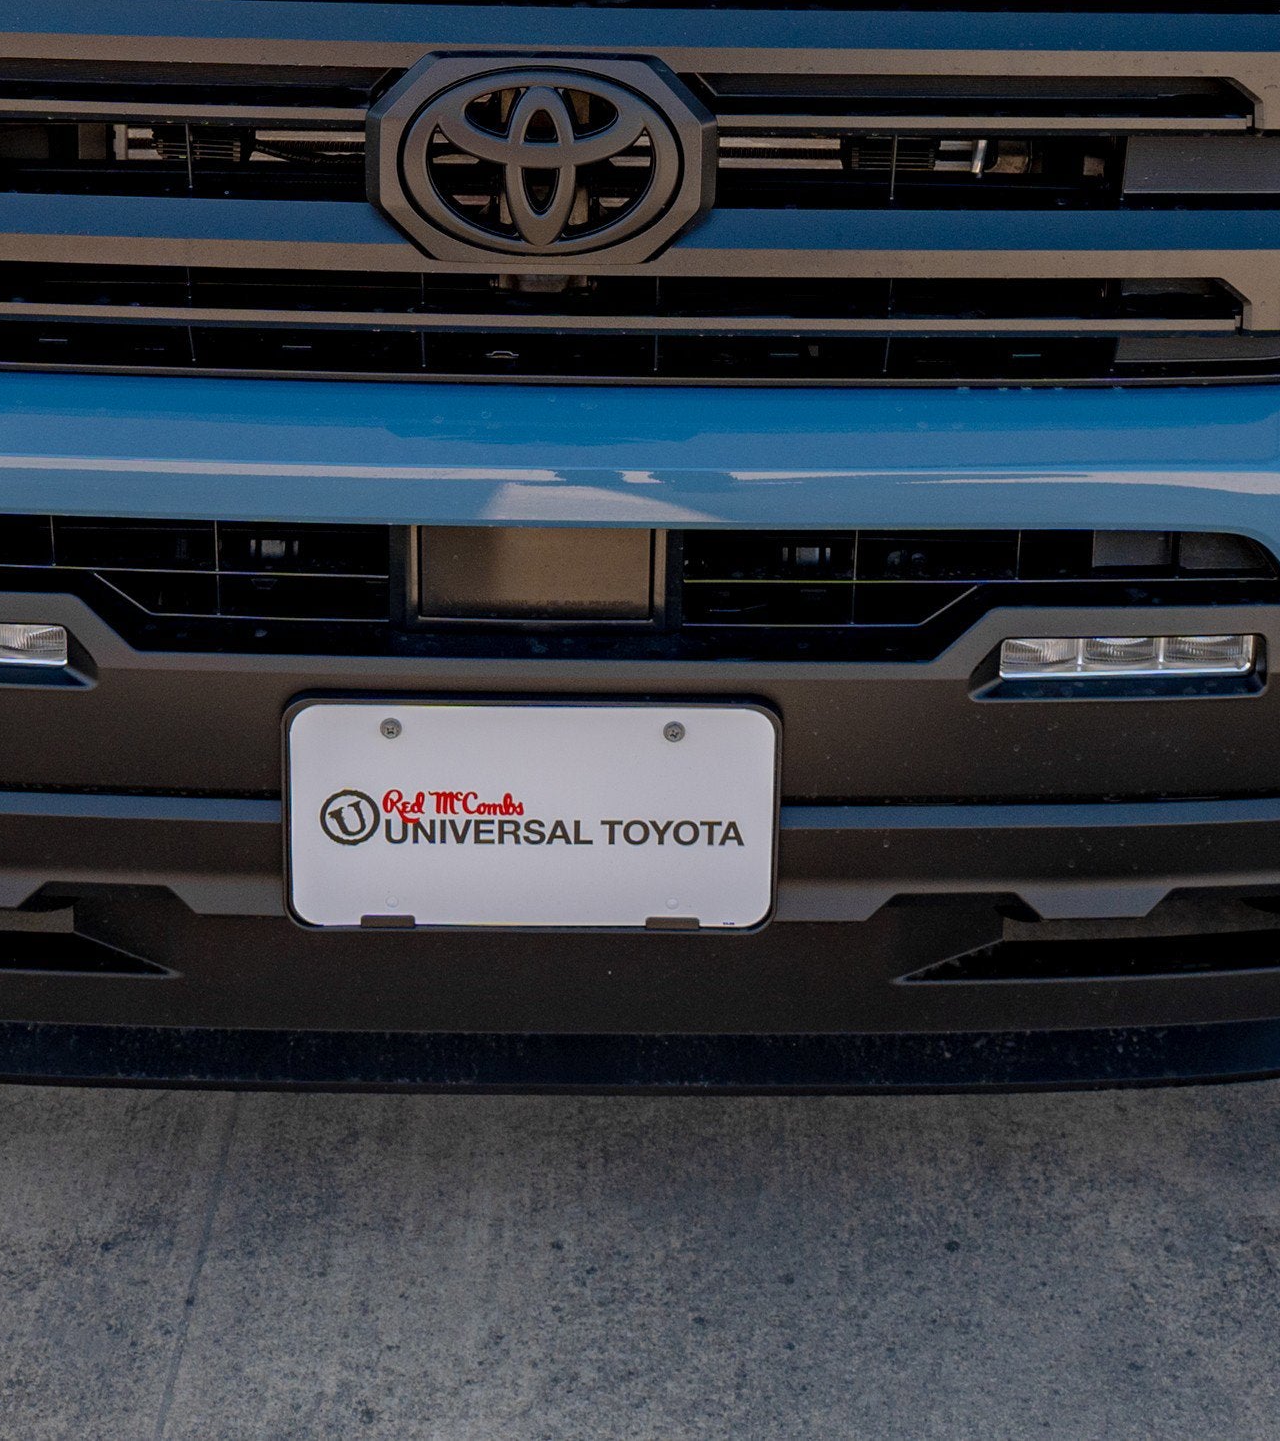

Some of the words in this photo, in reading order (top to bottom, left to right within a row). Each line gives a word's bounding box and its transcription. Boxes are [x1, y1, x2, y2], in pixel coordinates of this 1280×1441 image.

[382, 788, 426, 824] Red
[428, 790, 525, 818] McCombs
[383, 818, 593, 846] UNIVERSAL
[600, 819, 745, 847] TOYOTA
